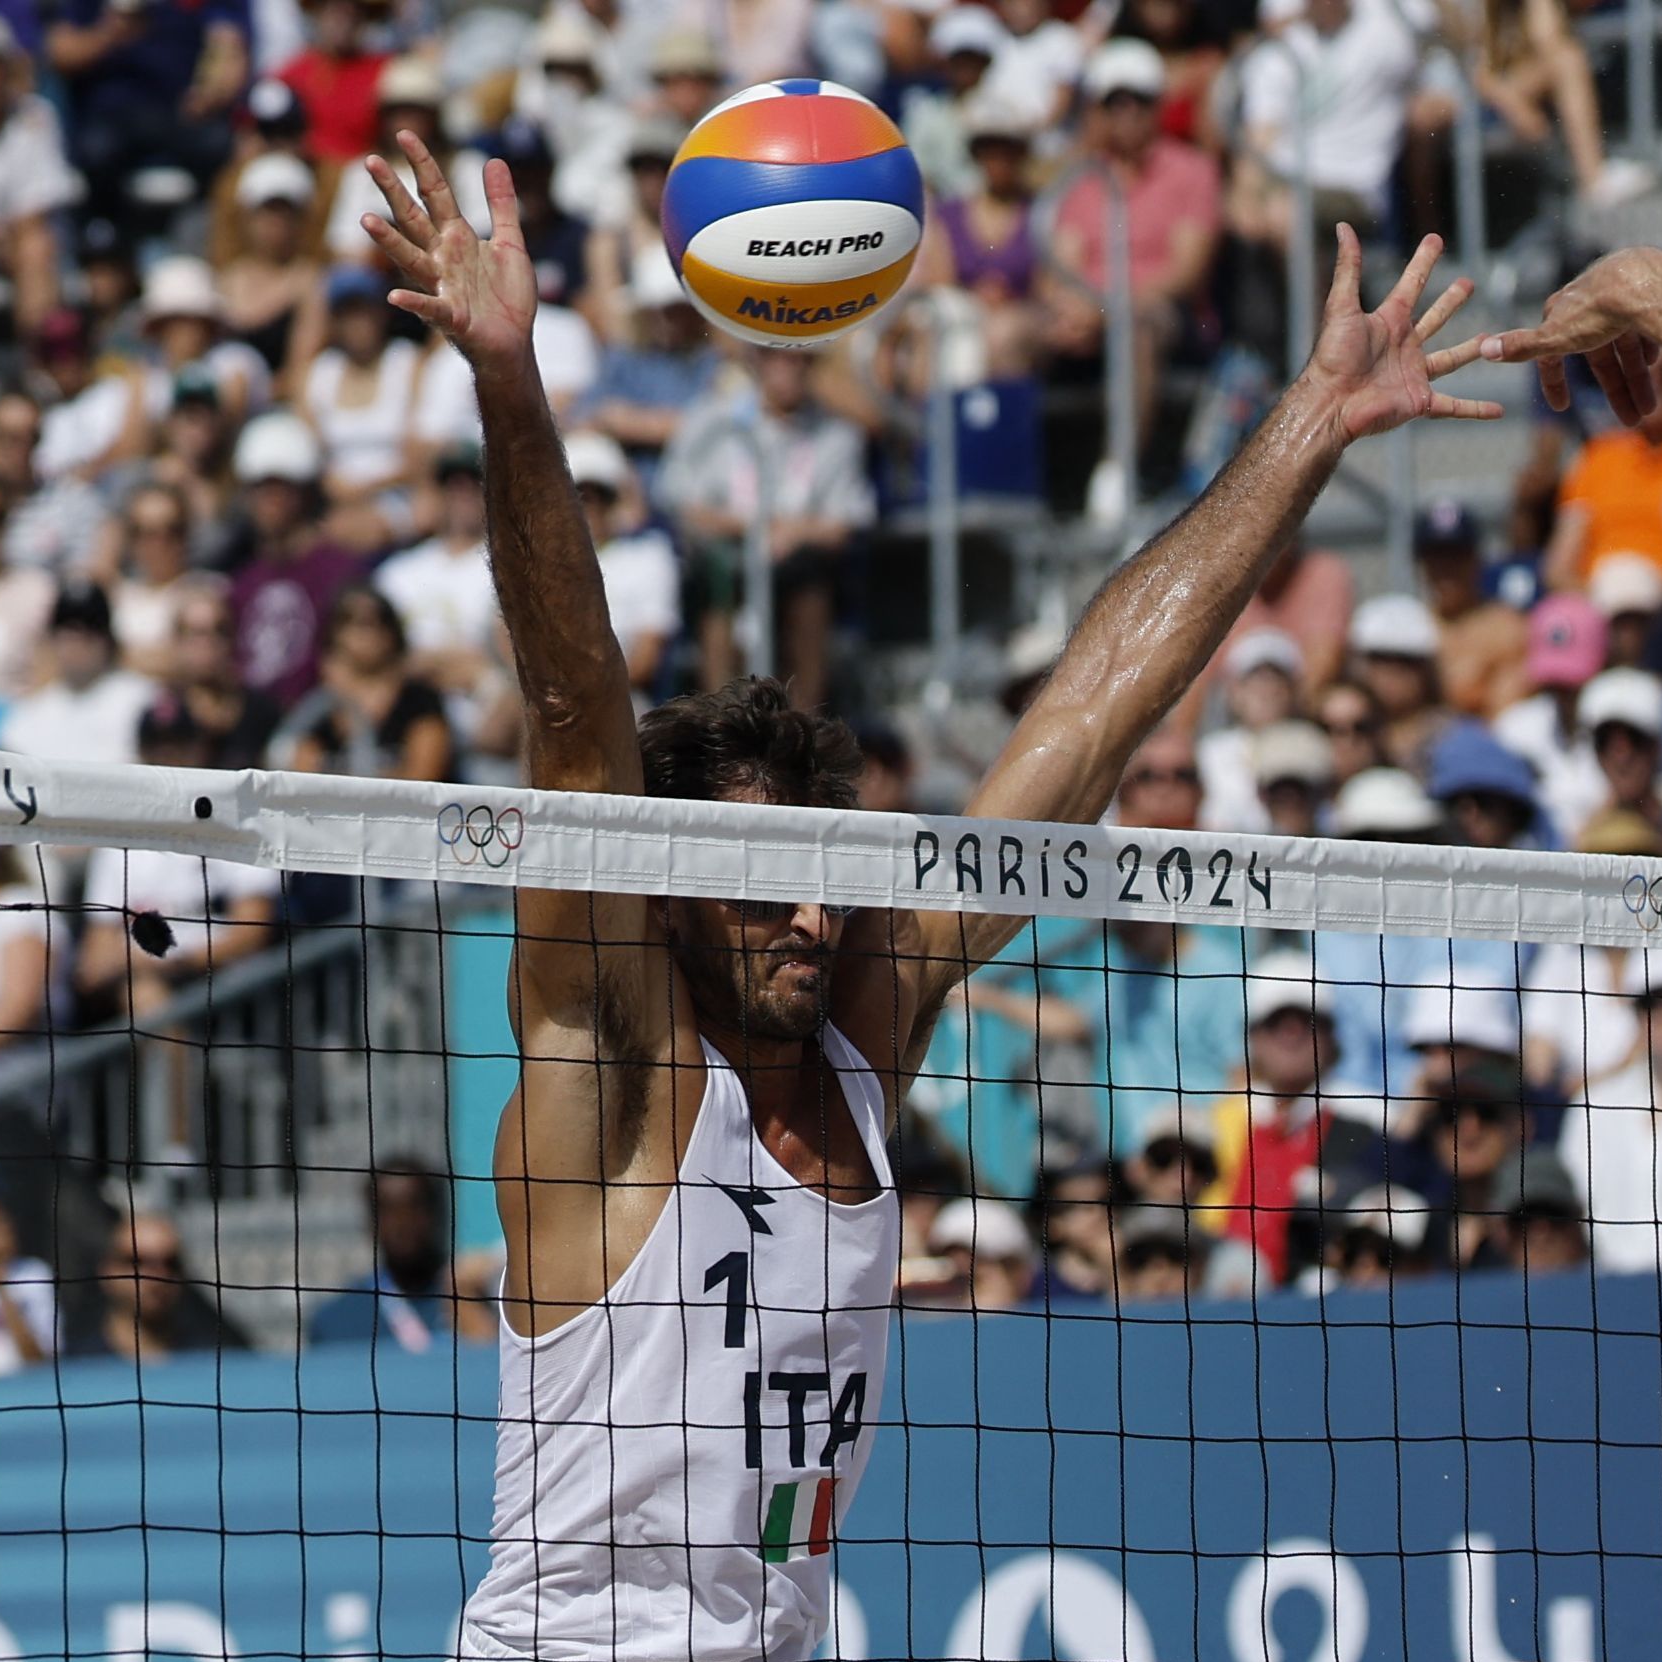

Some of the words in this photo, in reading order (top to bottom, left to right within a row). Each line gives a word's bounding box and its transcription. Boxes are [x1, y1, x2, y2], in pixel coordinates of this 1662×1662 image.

[747, 239, 831, 257] BEACH
[837, 231, 885, 254] PRO
[1116, 843, 1272, 909] 2024
[704, 1251, 749, 1348] 1
[743, 1371, 867, 1469] ITA
